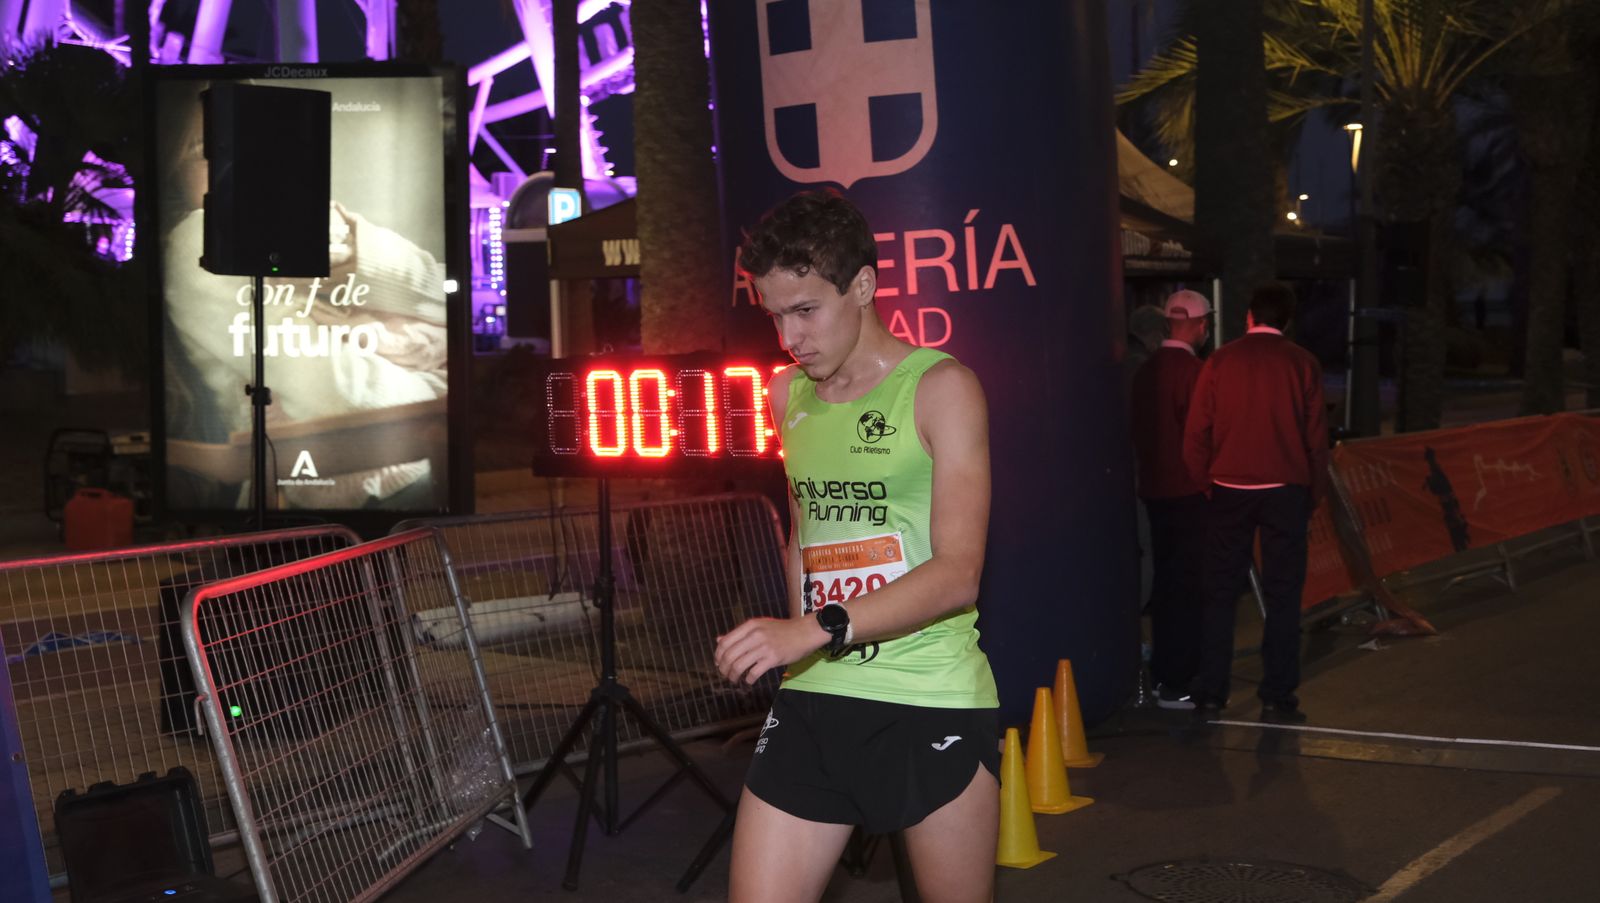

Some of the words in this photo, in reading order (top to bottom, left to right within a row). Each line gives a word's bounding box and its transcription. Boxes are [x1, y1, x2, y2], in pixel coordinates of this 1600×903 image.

[263, 66, 328, 78] JCDecaux
[553, 193, 575, 225] P
[236, 282, 295, 306] con
[330, 273, 370, 306] de
[228, 312, 378, 357] futuro
[809, 501, 888, 526] Running
